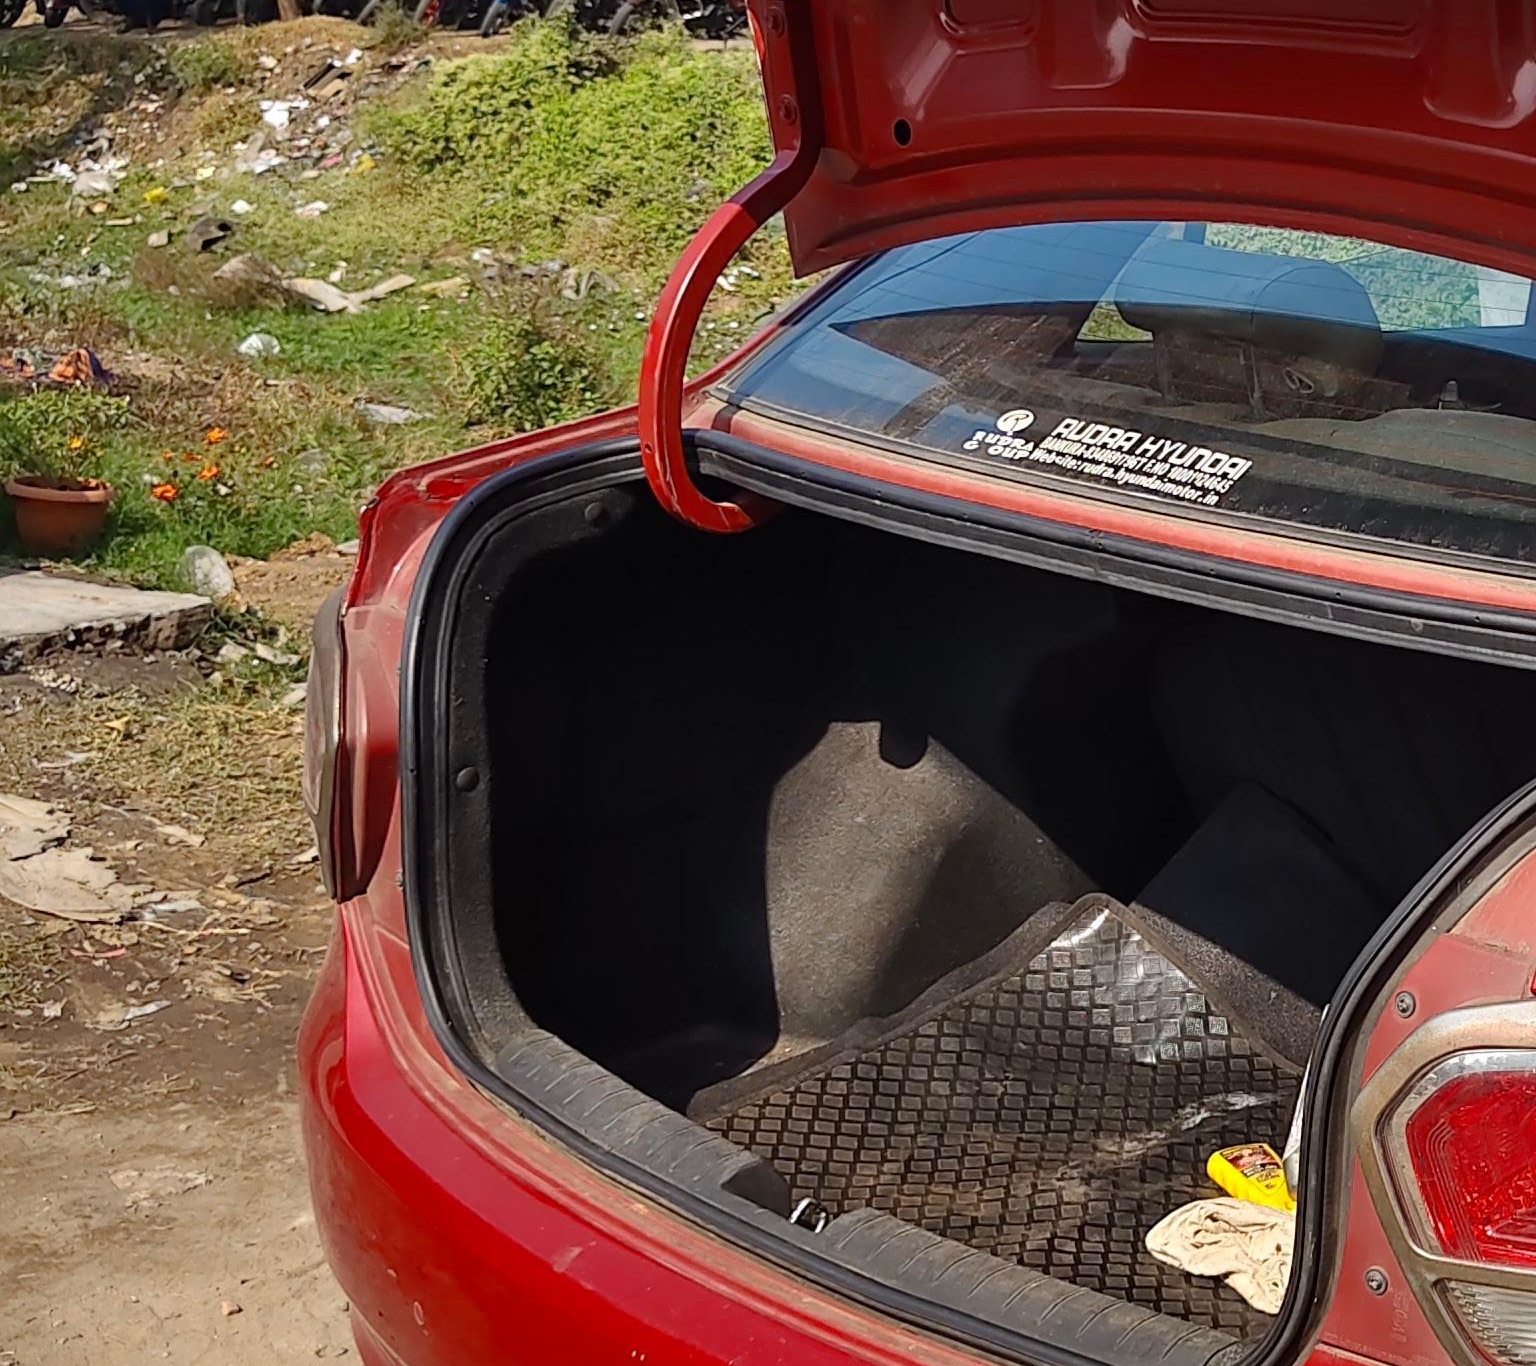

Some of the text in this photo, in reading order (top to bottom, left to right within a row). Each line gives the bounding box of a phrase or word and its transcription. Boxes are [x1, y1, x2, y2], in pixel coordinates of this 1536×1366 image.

[963, 440, 1030, 460] GOUP
[972, 431, 1035, 452] RUDRA
[1051, 418, 1253, 481] RUDRA HYUNDAI
